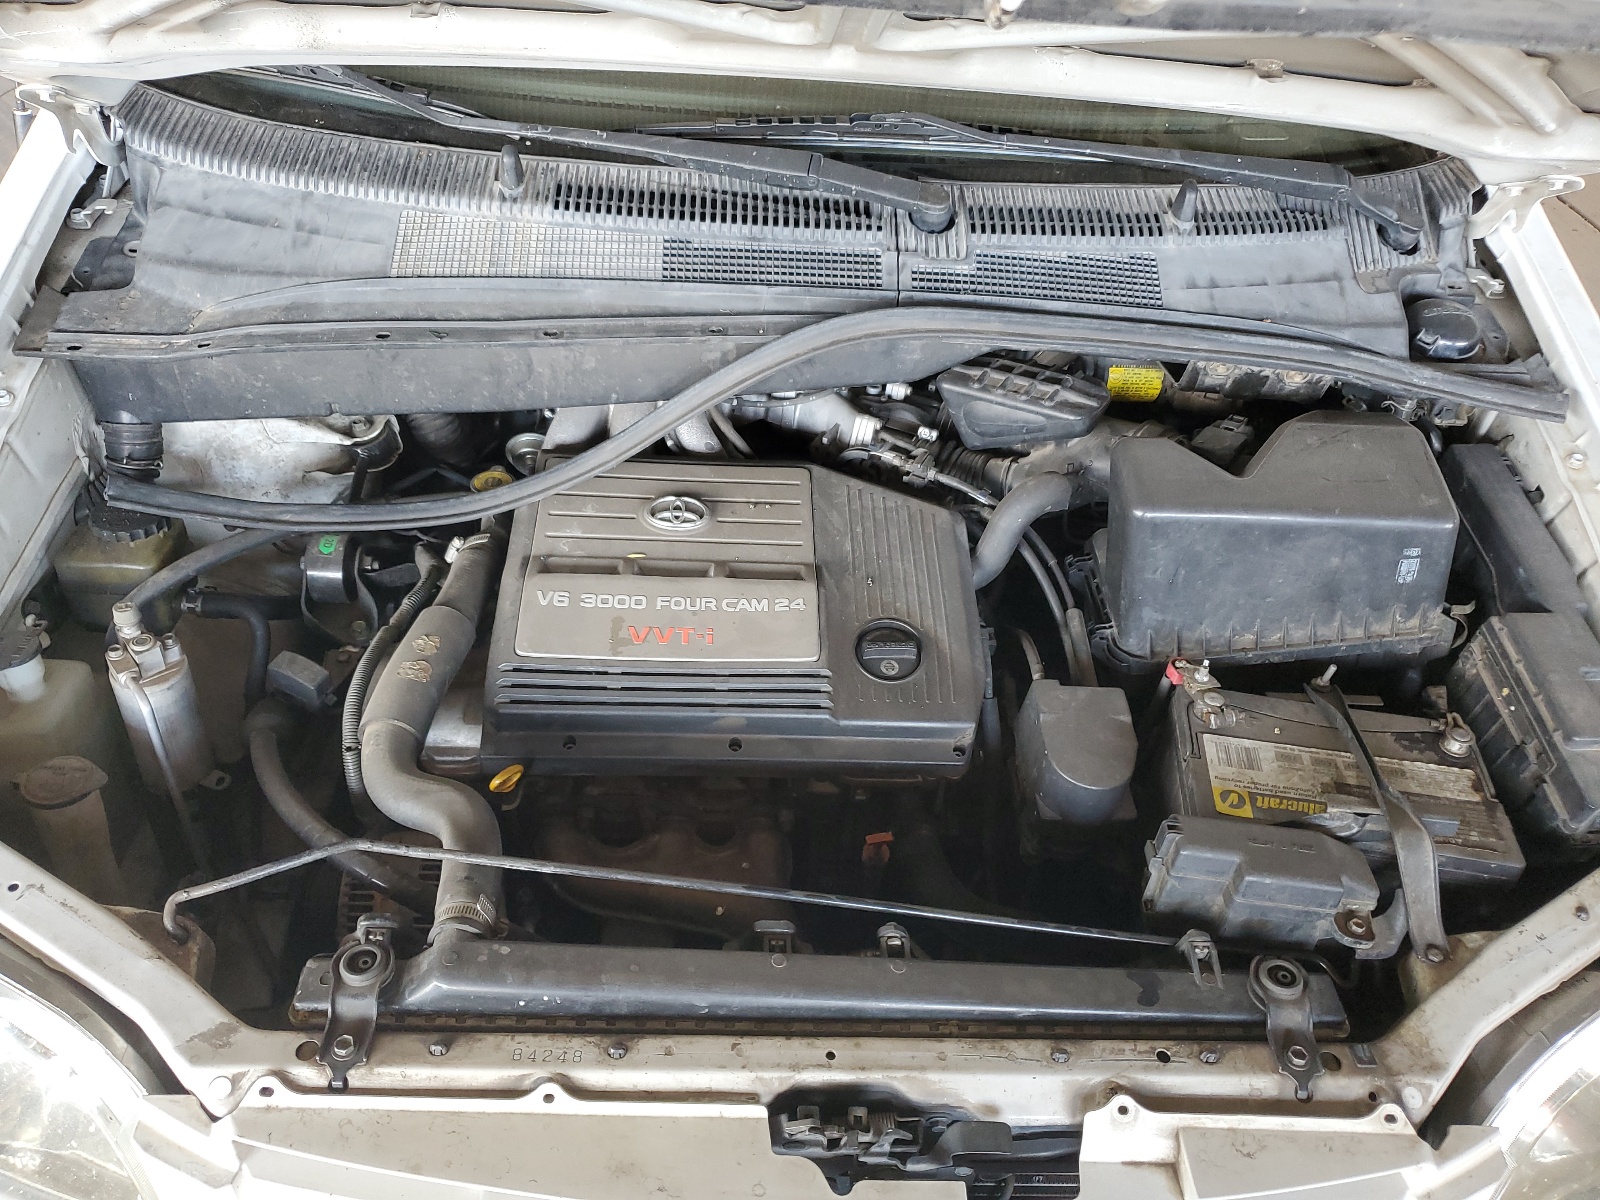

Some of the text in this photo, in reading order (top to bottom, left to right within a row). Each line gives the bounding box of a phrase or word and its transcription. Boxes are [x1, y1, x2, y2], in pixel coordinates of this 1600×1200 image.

[536, 590, 807, 612] V6 3000 FOUR CAM 24
[627, 625, 714, 645] VVT-i
[1243, 784, 1274, 794] batteries
[1275, 788, 1292, 796] used
[512, 1047, 583, 1063] 84248
